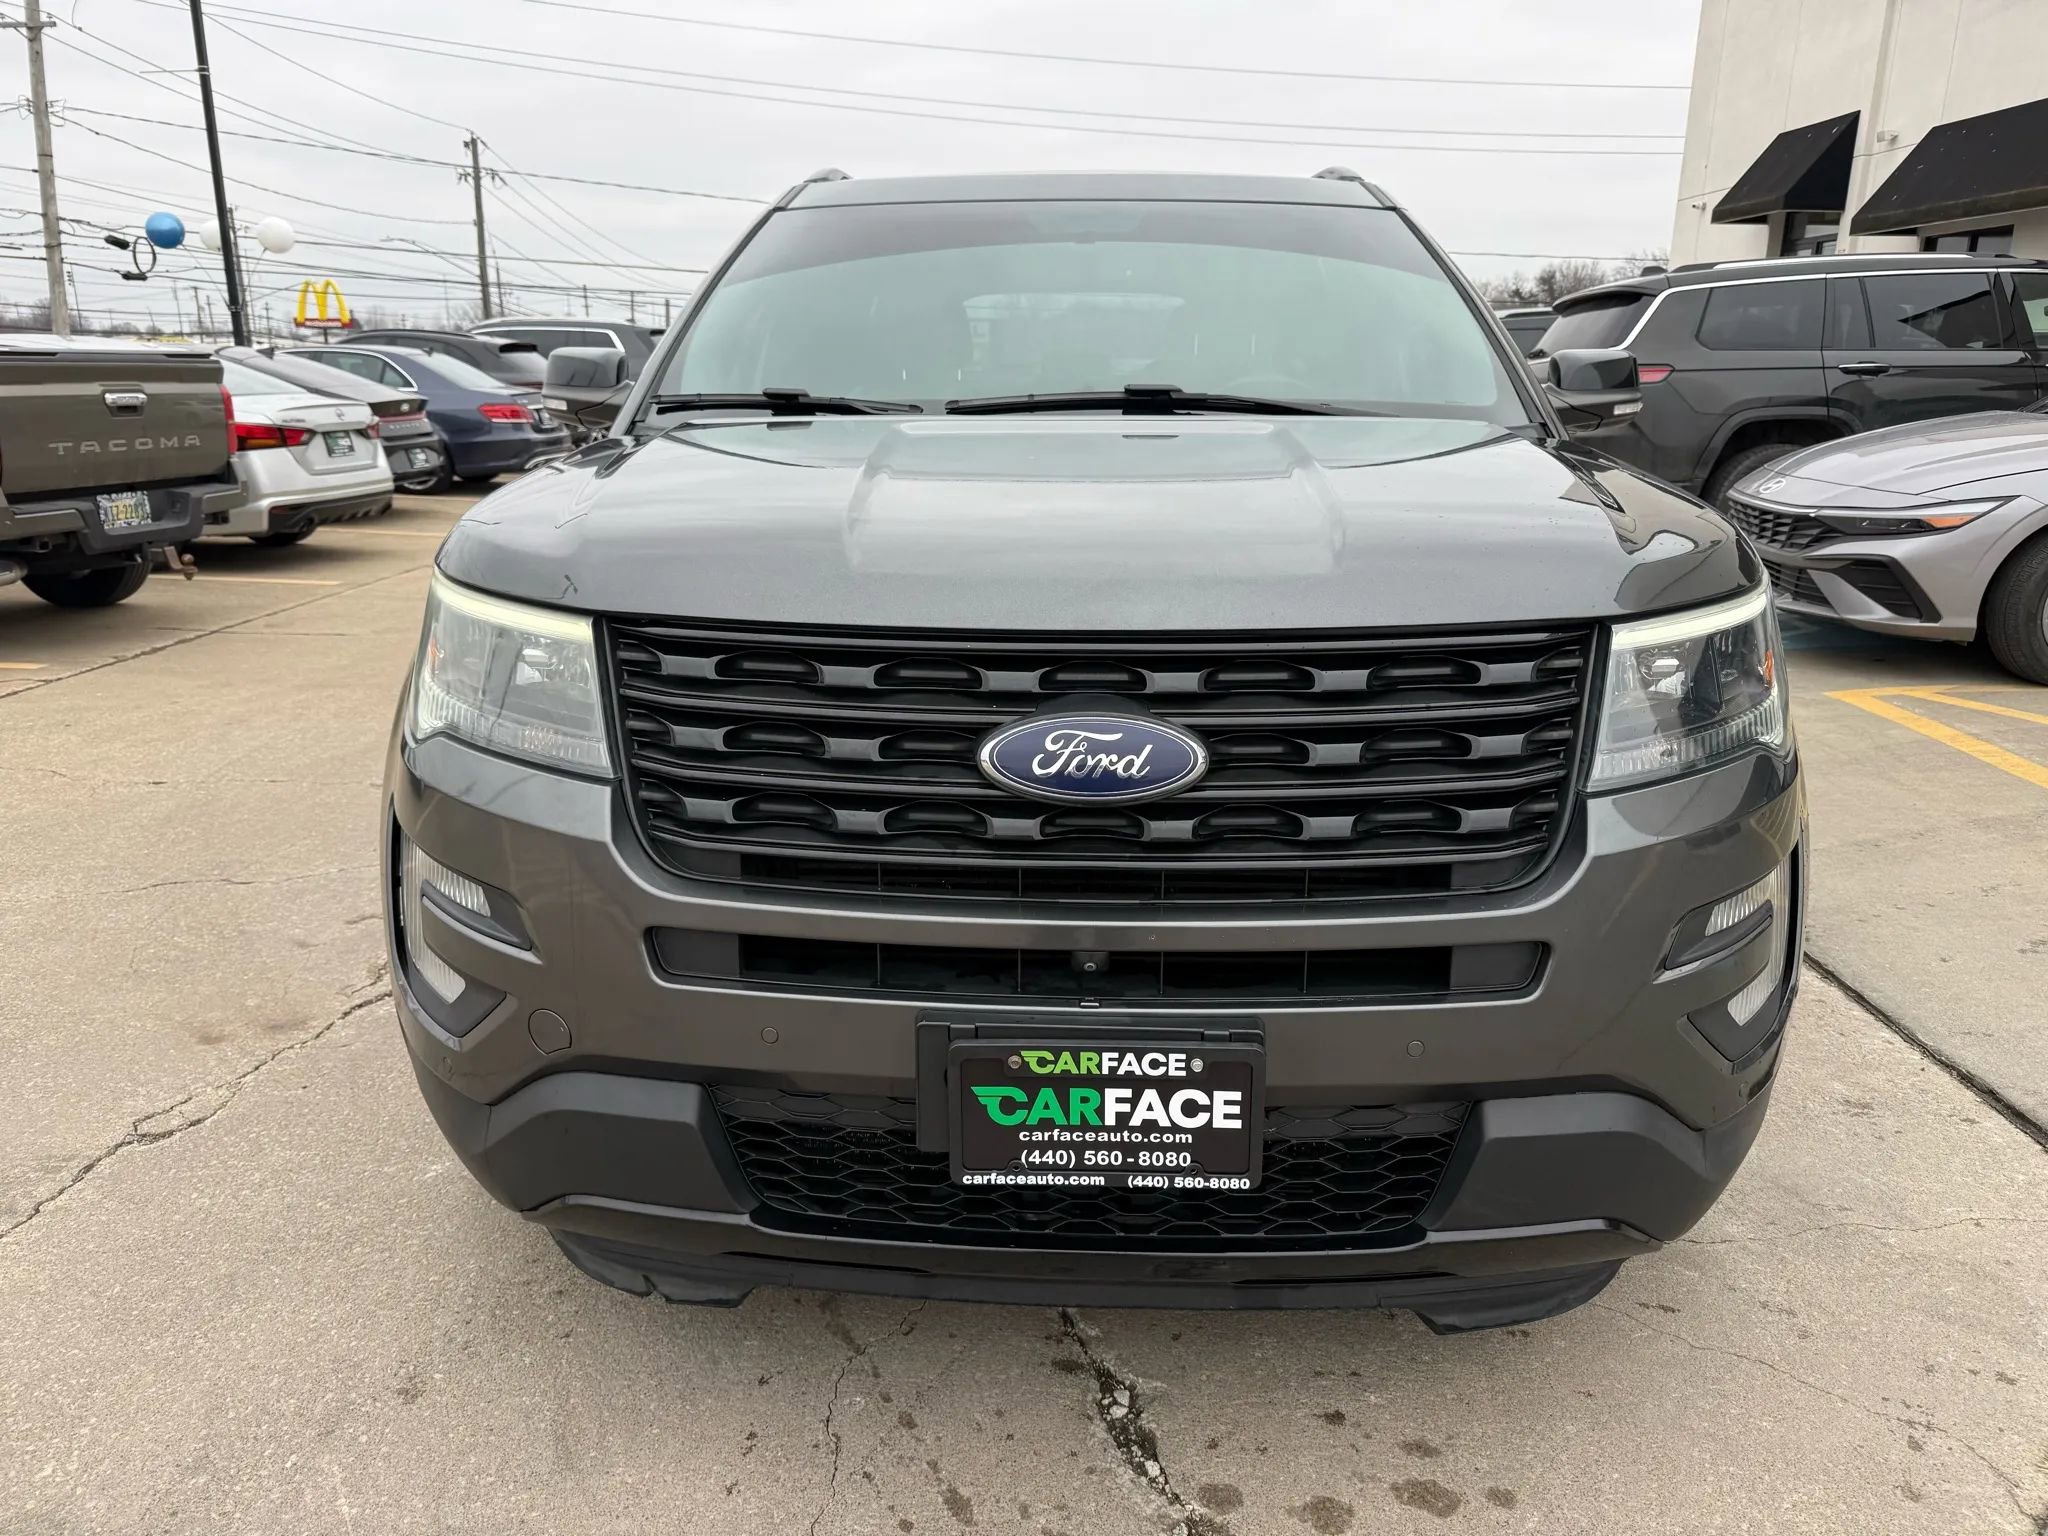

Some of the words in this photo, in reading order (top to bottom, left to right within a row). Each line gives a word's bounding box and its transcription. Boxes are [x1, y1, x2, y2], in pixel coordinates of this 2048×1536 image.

[48, 435, 201, 455] TACOMA
[1031, 729, 1153, 779] Ford
[1020, 1050, 1187, 1077] CARFACE
[970, 1086, 1243, 1130] CARFACE
[1018, 1128, 1193, 1144] carfaceauto.com
[1020, 1149, 1076, 1168] (440)
[962, 1172, 1106, 1186] carfaceauto.com
[1127, 1175, 1169, 1189] (440)
[1173, 1176, 1251, 1190] 560-8080
